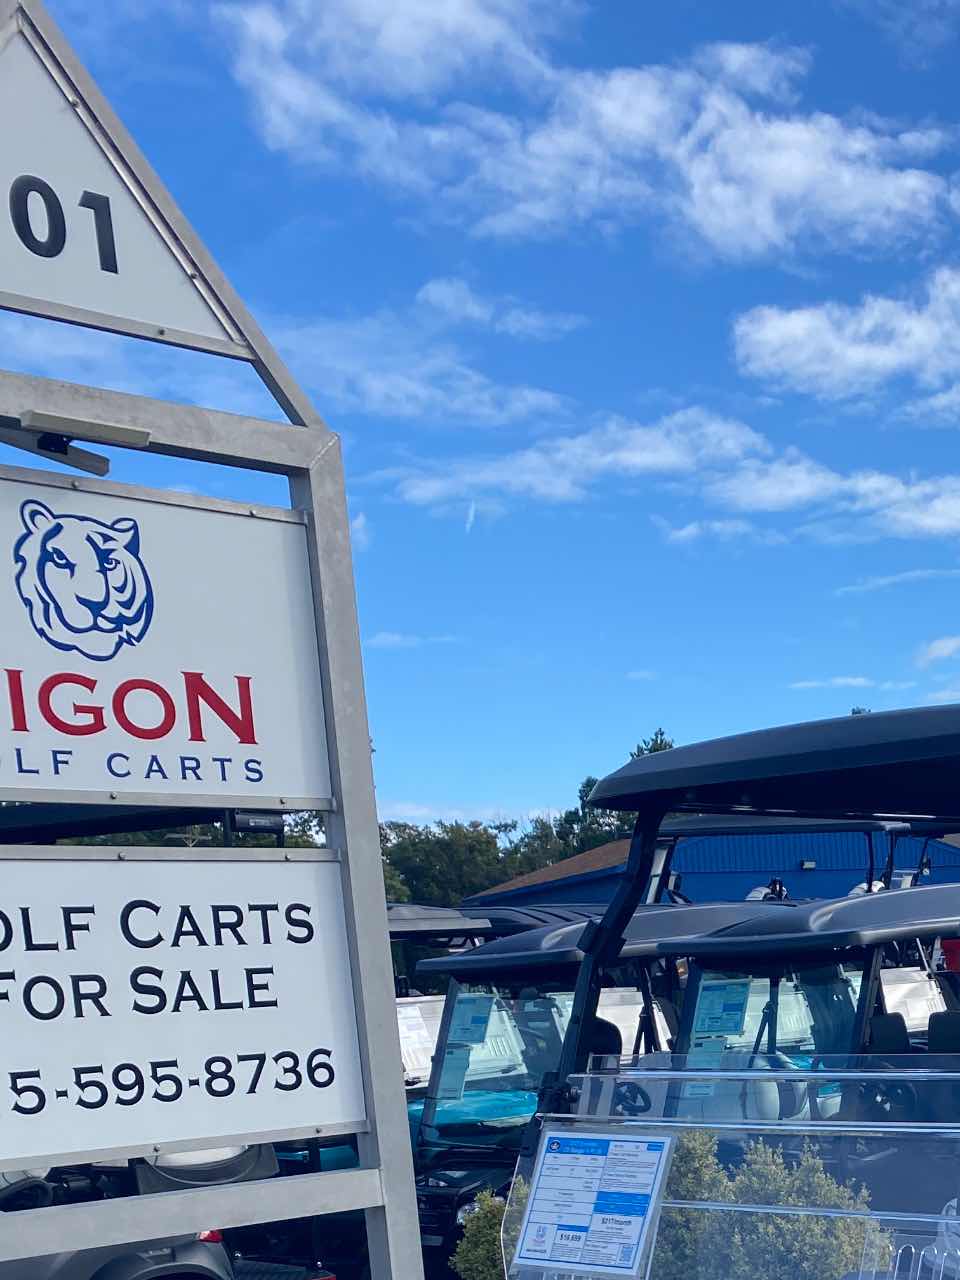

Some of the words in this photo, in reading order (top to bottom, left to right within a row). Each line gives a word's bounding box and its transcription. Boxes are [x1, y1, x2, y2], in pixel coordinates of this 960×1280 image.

[9, 174, 119, 275] 01
[0, 747, 74, 776] LF
[106, 752, 265, 783] CARTS
[119, 899, 315, 949] CARTS
[129, 965, 279, 1015] SALE
[8, 1048, 336, 1115] 5-595-8736
